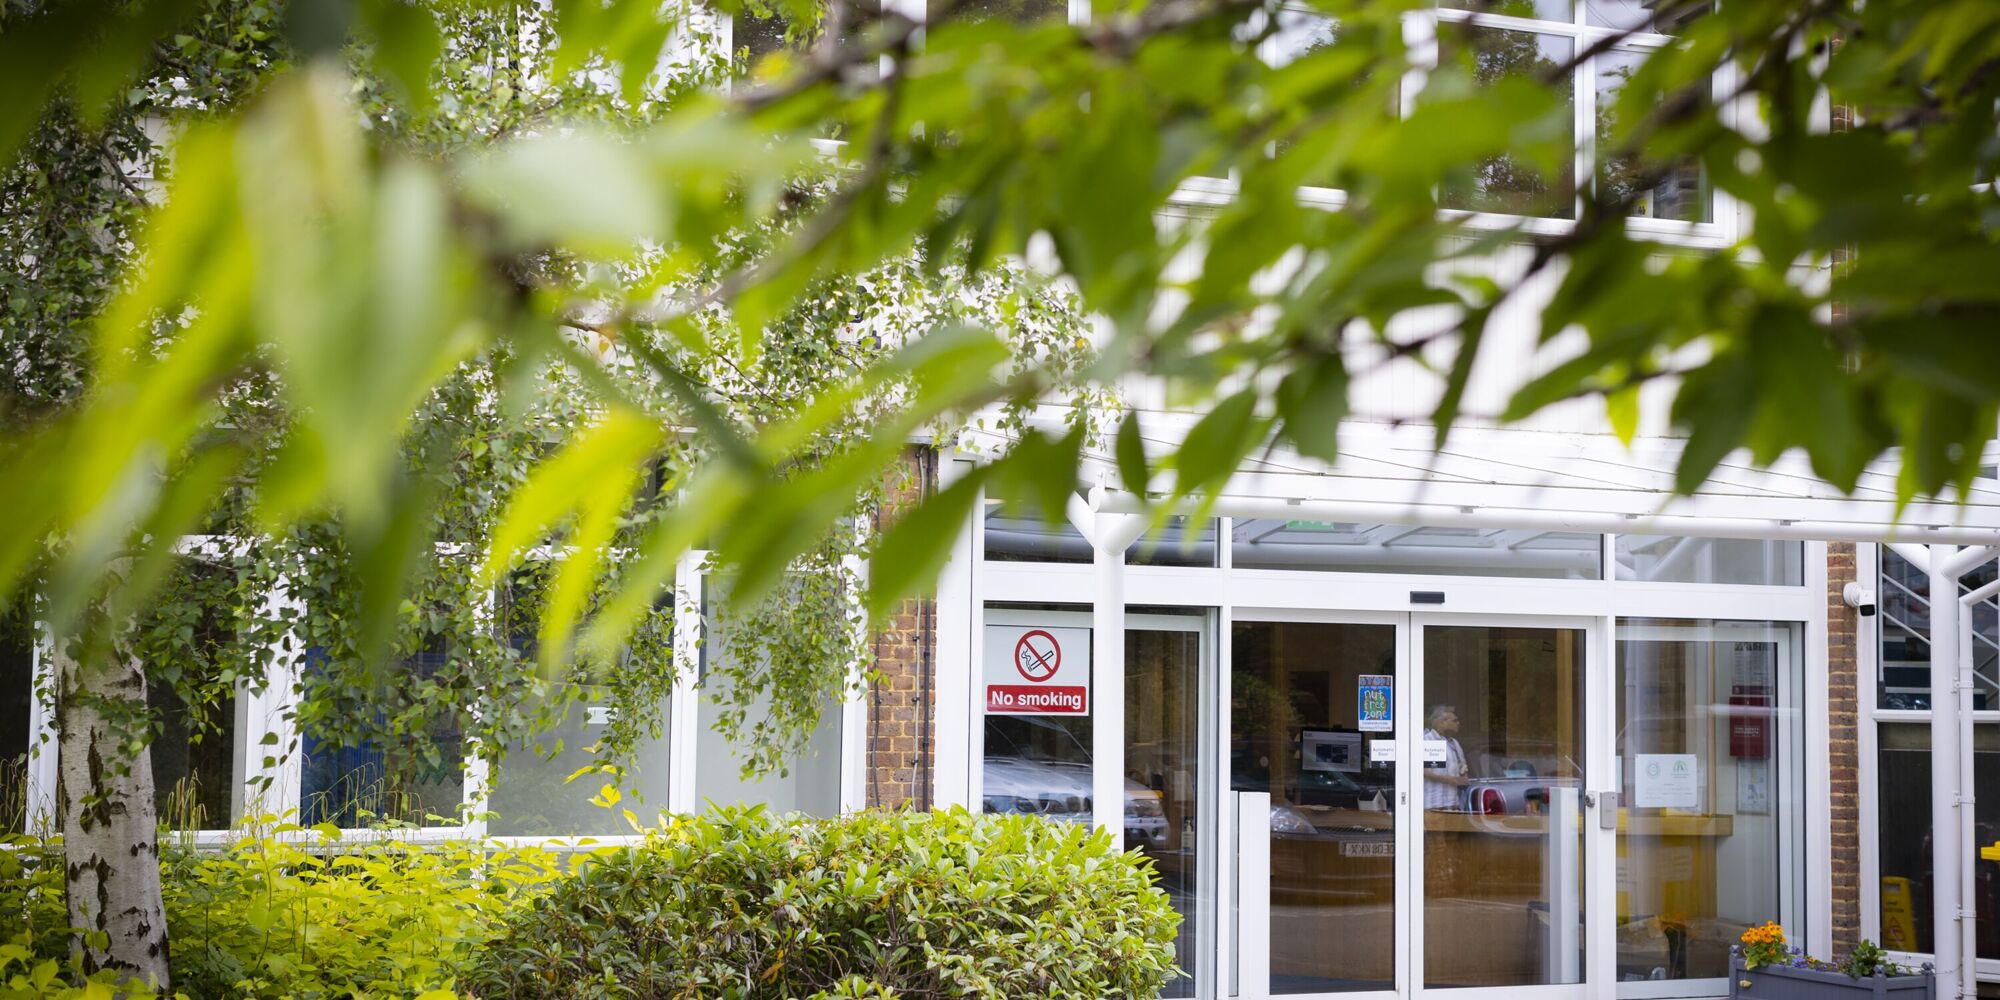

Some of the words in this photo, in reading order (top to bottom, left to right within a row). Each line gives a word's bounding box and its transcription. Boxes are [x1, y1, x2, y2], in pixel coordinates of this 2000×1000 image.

[991, 690, 1014, 705] No
[1017, 691, 1081, 710] smoking
[1364, 690, 1385, 700] nut
[1364, 700, 1385, 709] free
[1363, 710, 1388, 720] zone
